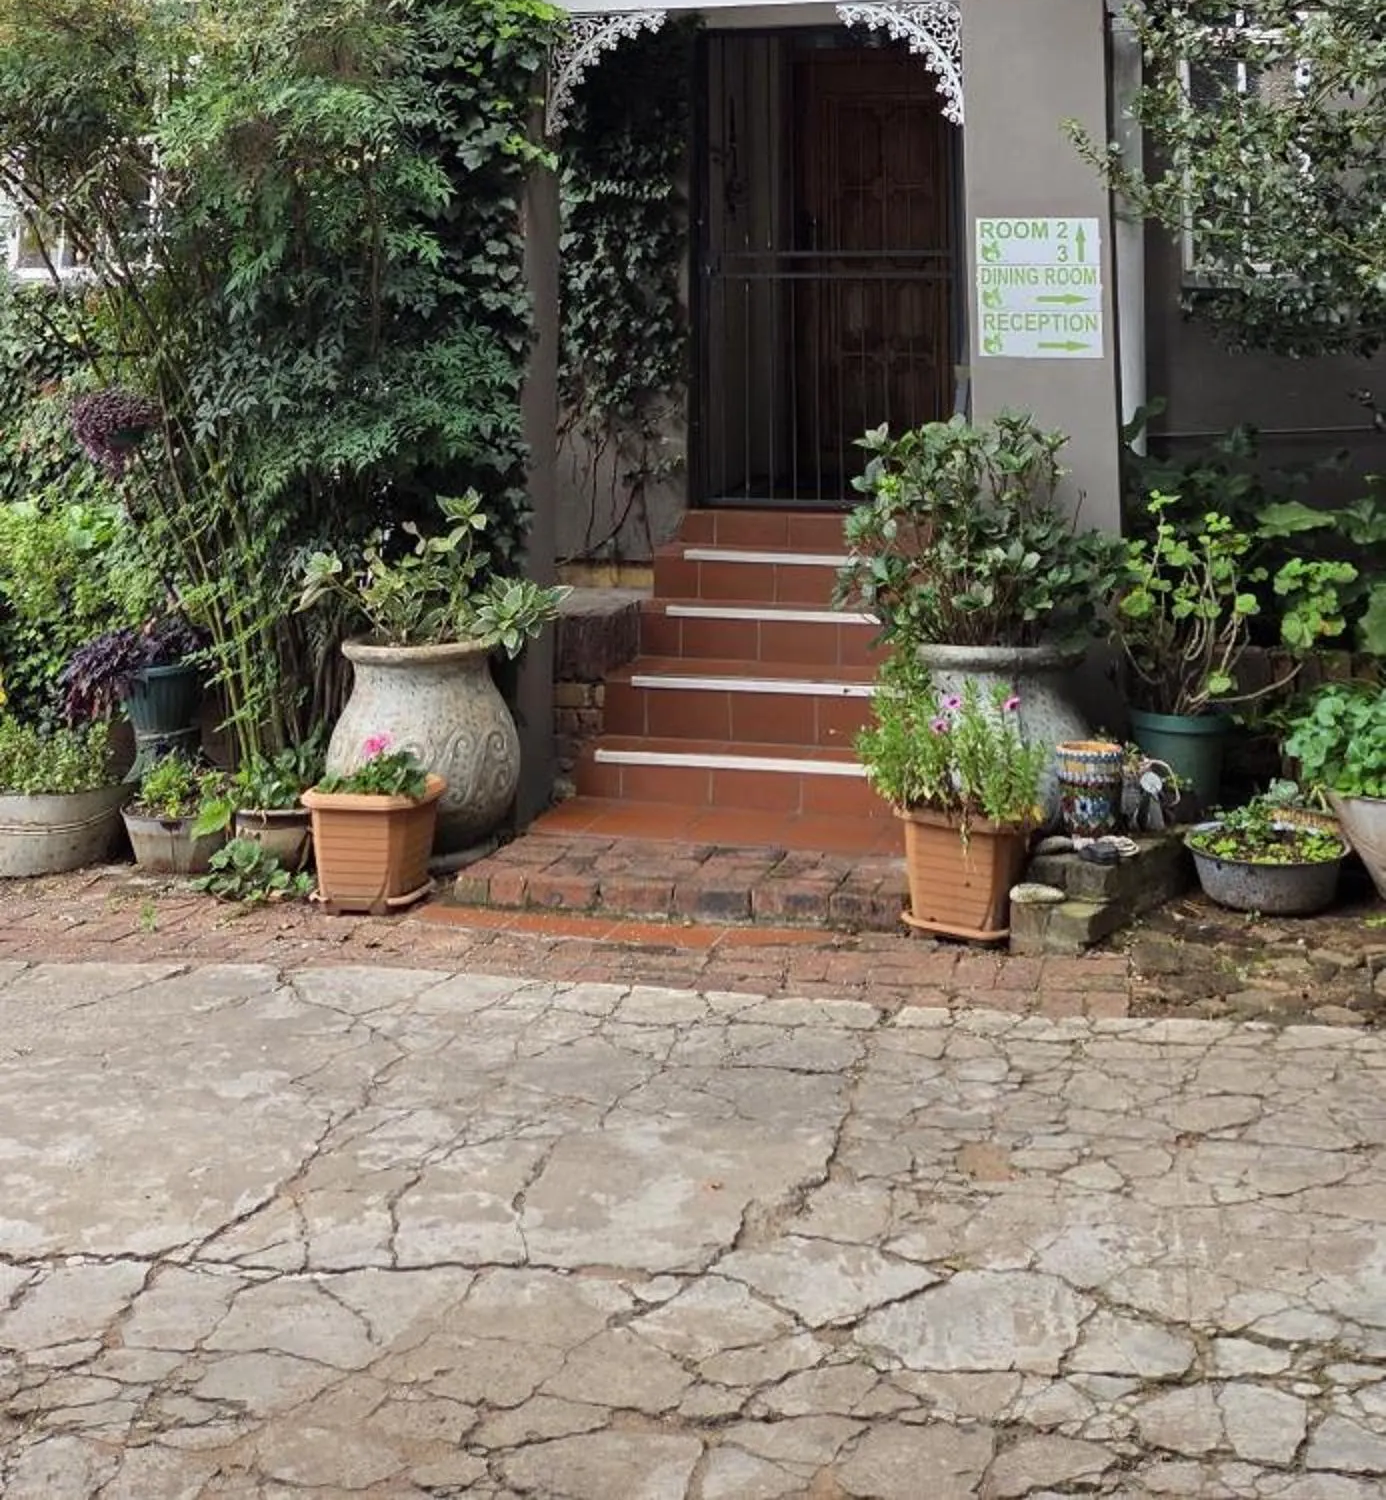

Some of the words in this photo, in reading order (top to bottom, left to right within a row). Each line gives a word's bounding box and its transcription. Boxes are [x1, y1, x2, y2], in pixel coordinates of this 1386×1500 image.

[980, 221, 1049, 239] ROOM
[1056, 221, 1069, 239] 2
[1056, 245, 1069, 263] 3
[981, 267, 1039, 285] DINING
[1045, 267, 1097, 285] ROOM
[983, 313, 1098, 332] RECEPTION
